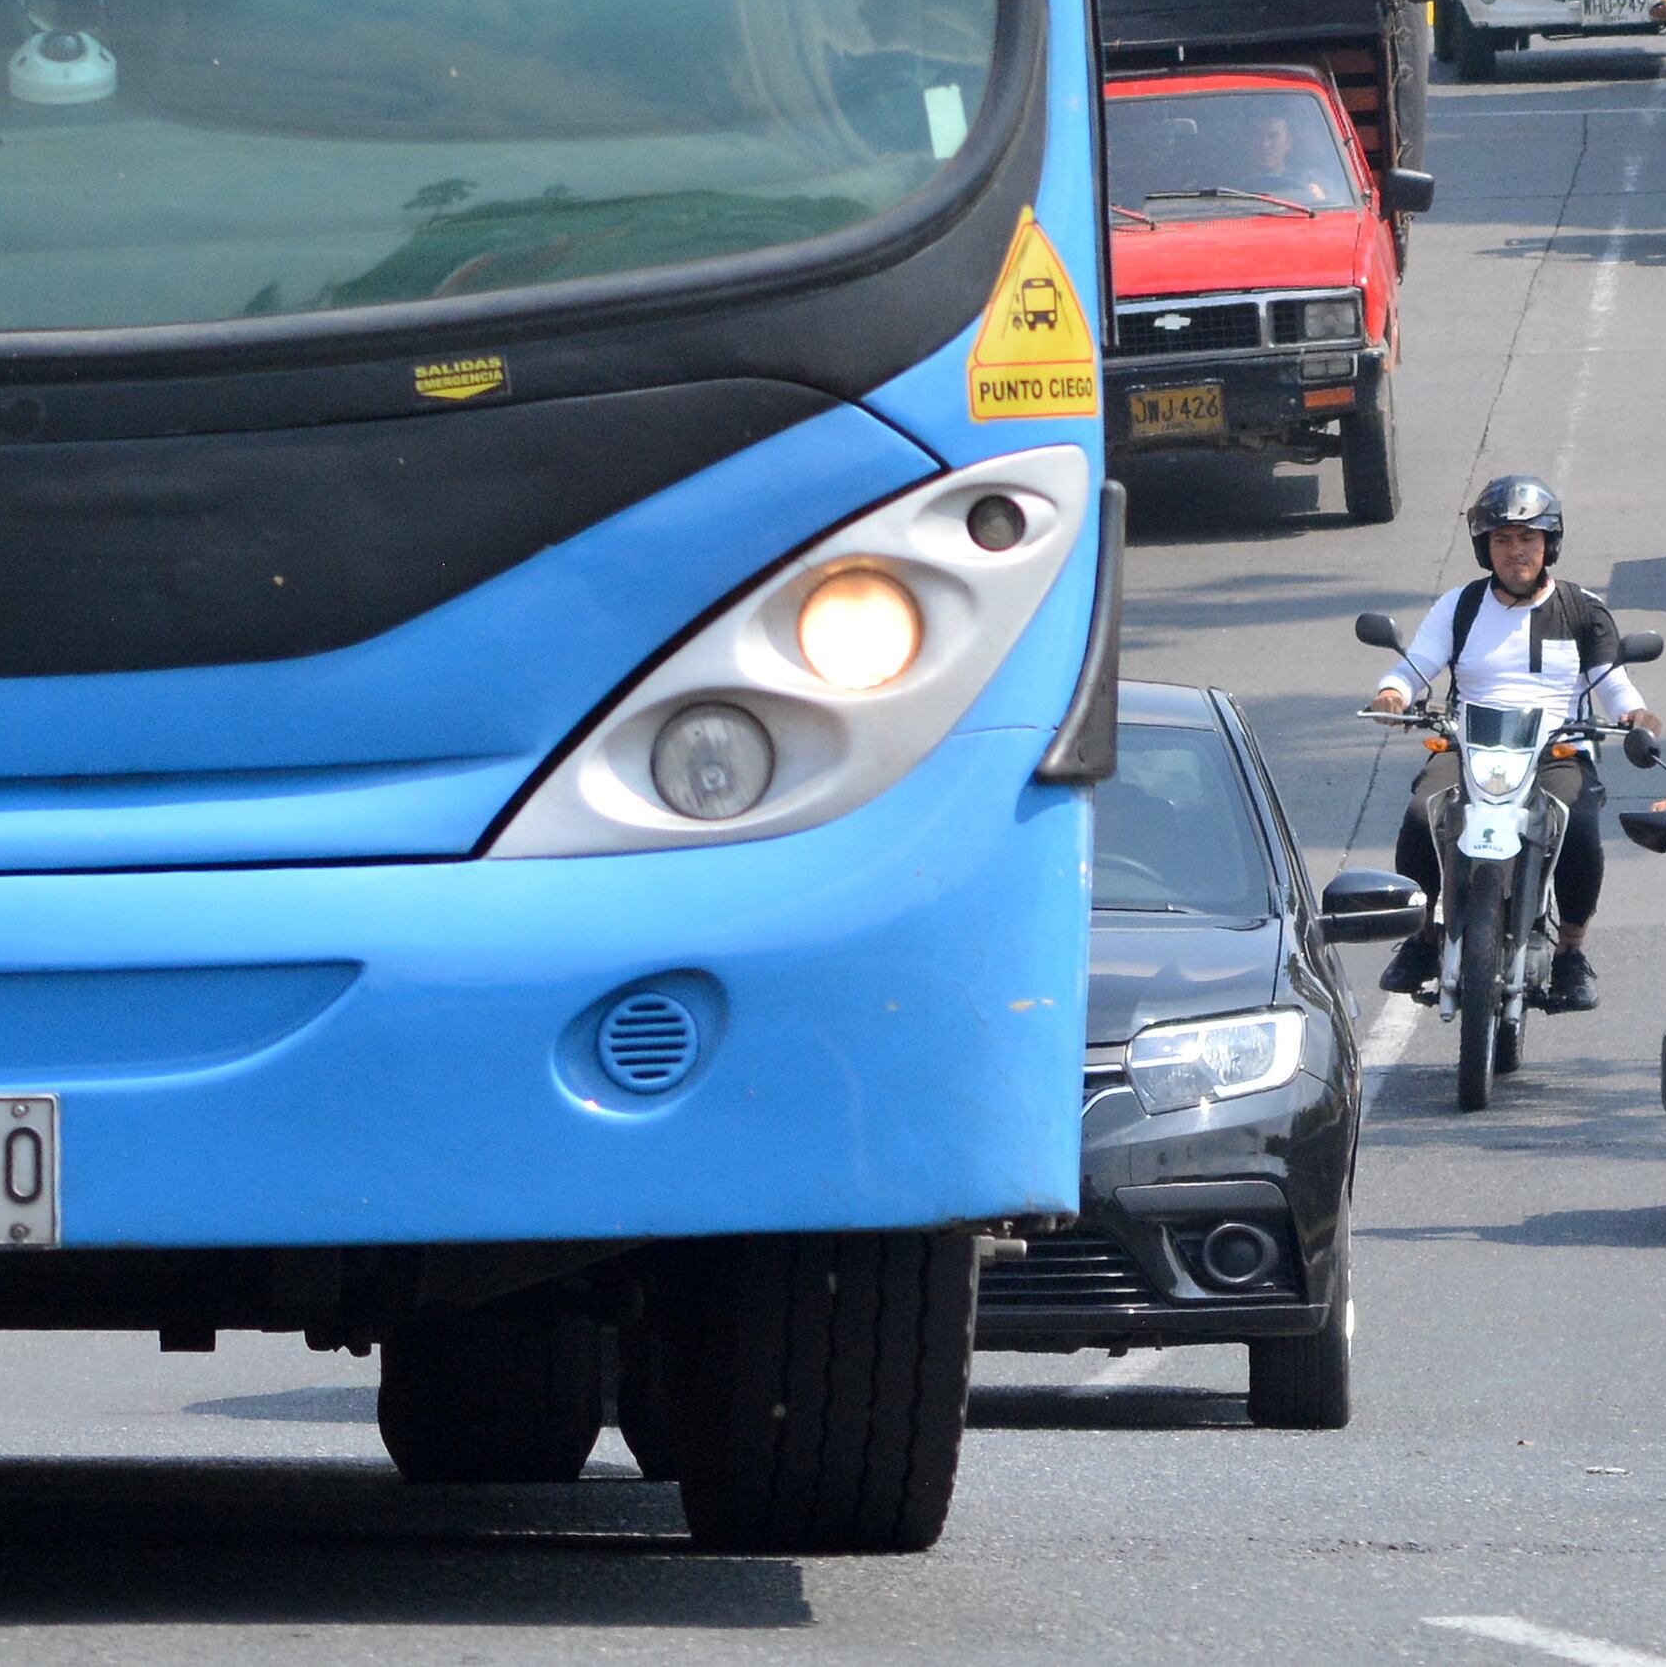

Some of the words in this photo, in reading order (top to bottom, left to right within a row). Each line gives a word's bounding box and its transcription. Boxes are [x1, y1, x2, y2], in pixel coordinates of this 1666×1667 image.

[414, 356, 503, 379] SALIDAS
[978, 378, 1044, 403] PUNTO
[1049, 376, 1093, 399] CIEGO
